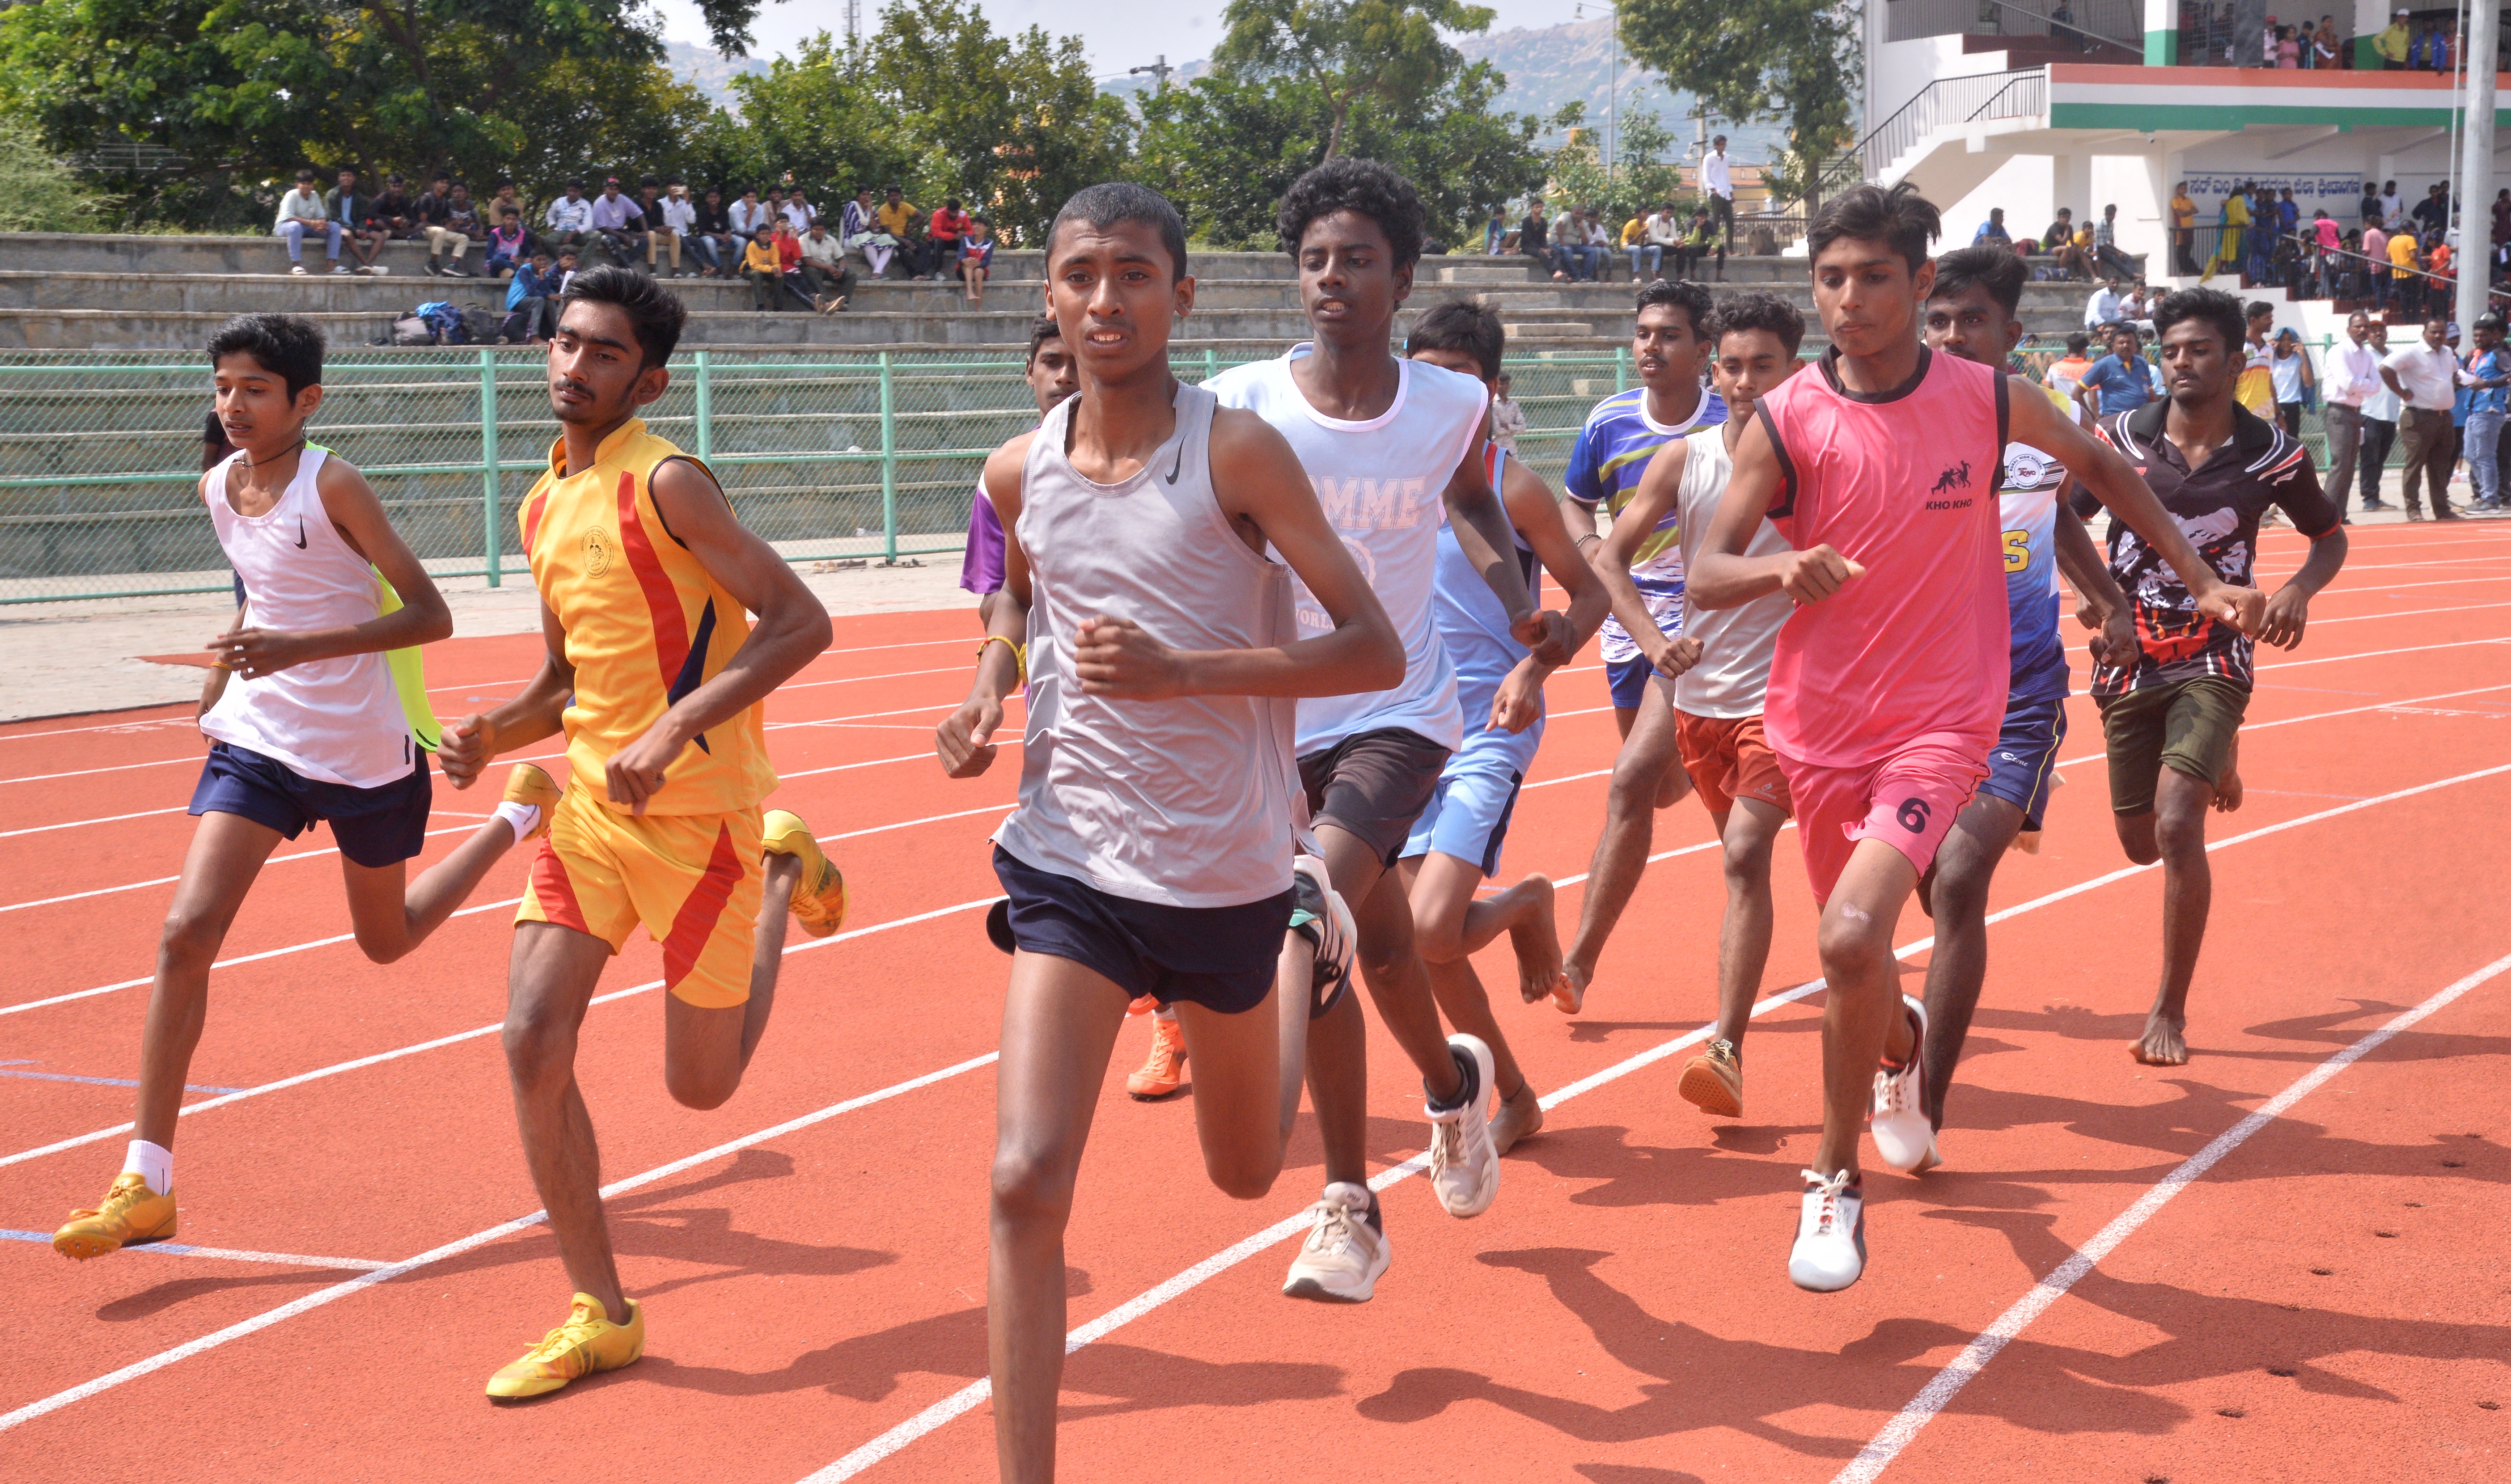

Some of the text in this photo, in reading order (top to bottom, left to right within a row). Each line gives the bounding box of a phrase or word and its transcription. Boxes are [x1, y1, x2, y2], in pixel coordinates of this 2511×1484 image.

[2213, 179, 2230, 194] ಎಂ
[2031, 457, 2043, 469] SCHOOL
[1926, 499, 1972, 510] KHO KHO
[2001, 529, 2029, 573] S
[1296, 609, 1336, 630] ORL
[2001, 752, 2028, 766] Ezone
[1896, 797, 1931, 834] 6
